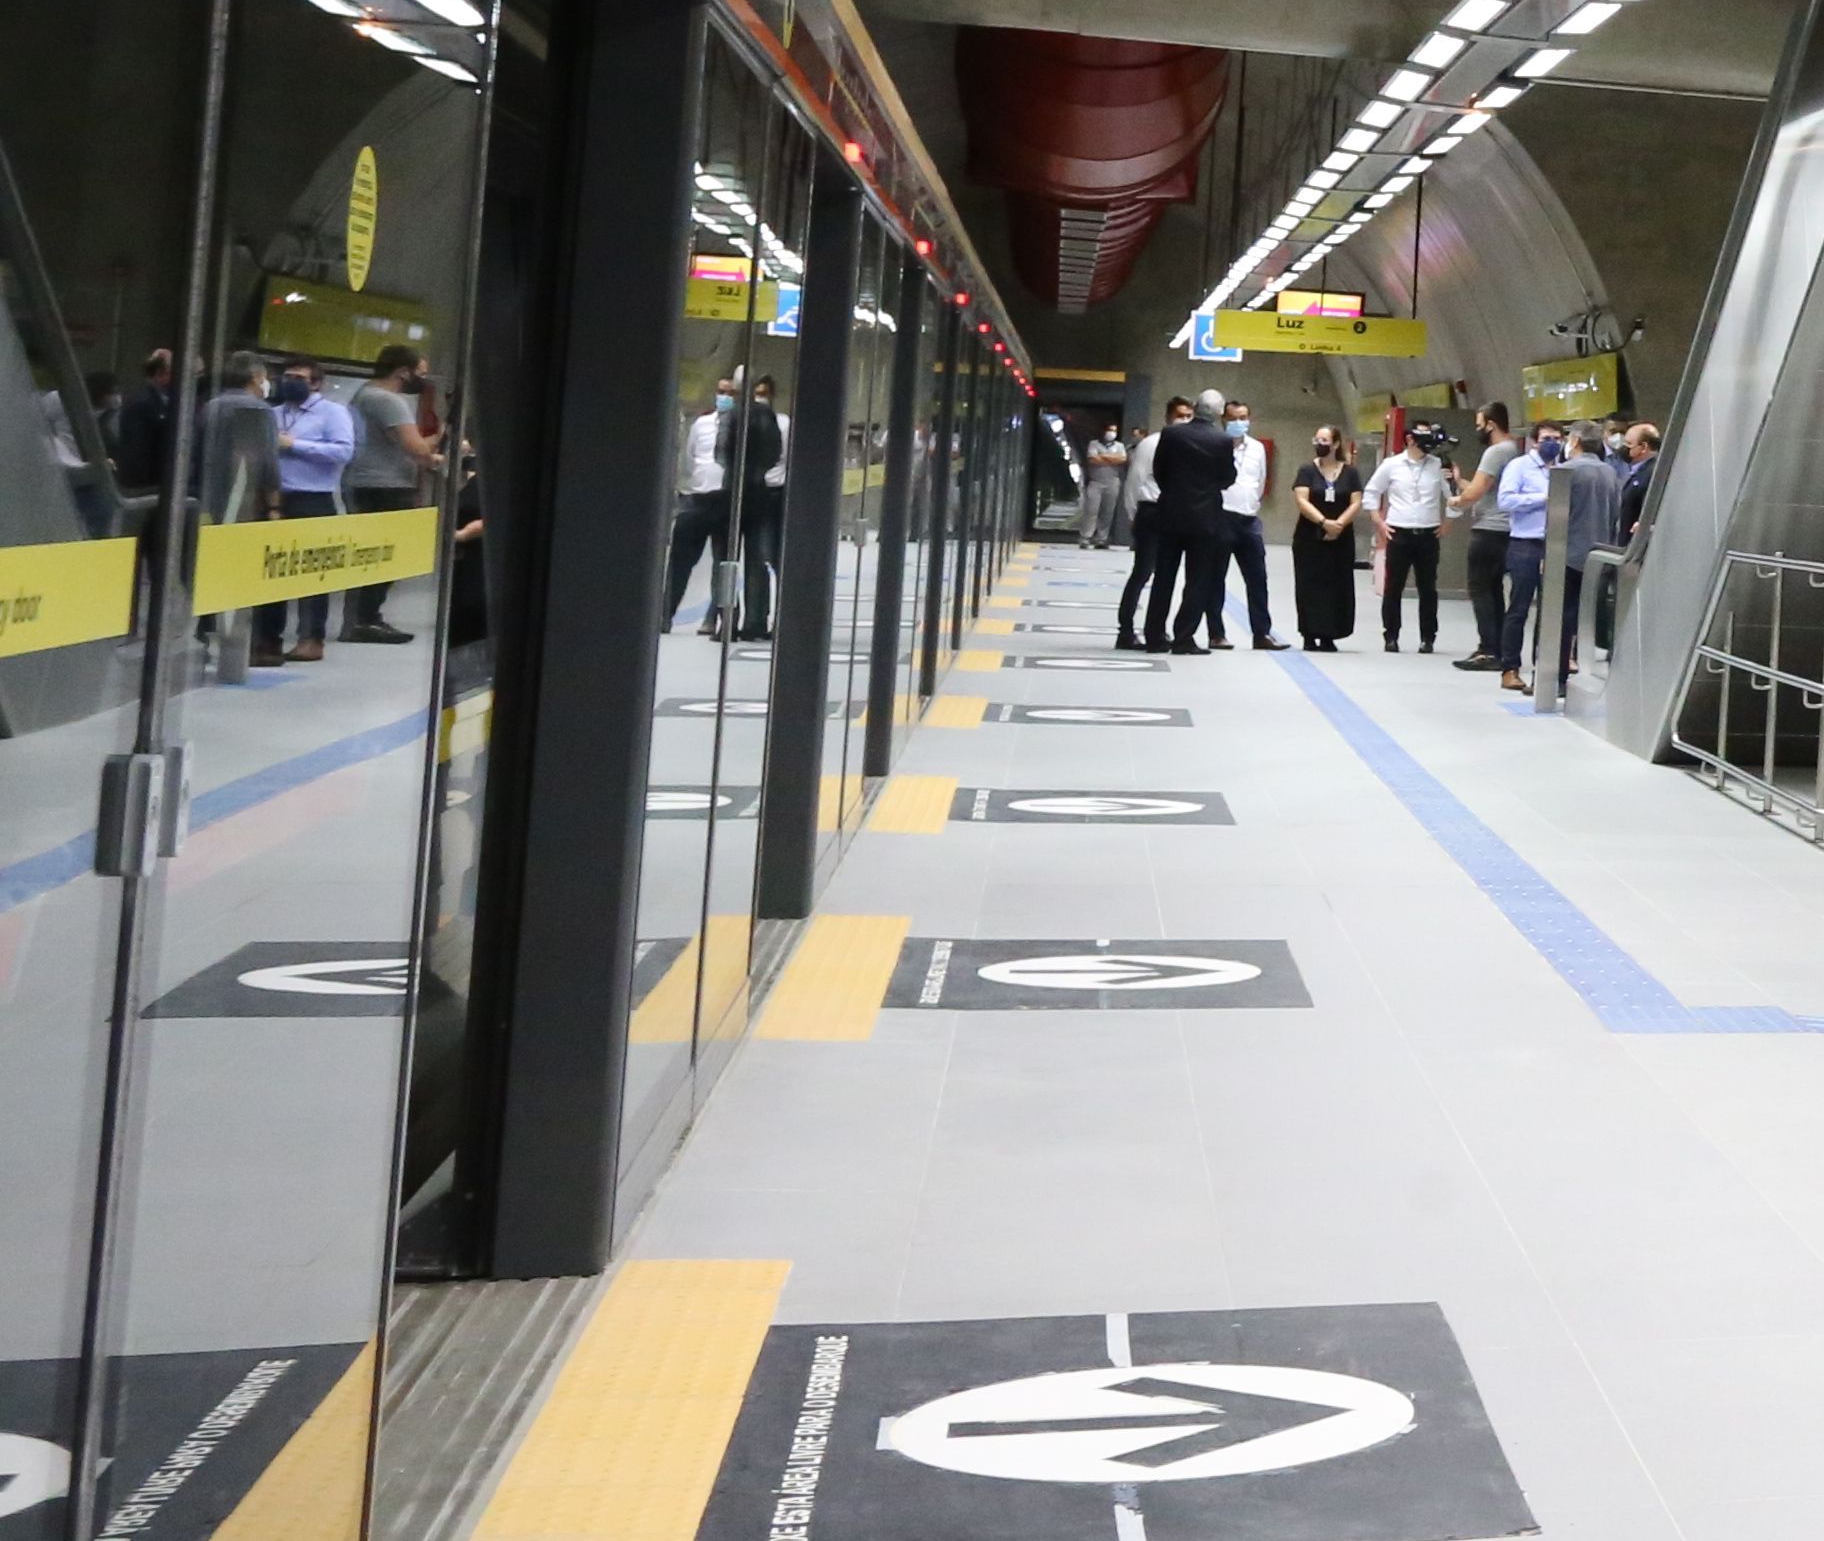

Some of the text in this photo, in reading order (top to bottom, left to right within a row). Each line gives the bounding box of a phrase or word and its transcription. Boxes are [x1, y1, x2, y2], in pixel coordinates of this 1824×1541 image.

[1277, 316, 1304, 329] Luz
[804, 1335, 848, 1398] DESEMBARQUE
[802, 1399, 836, 1408] O
[794, 1408, 834, 1435] PARA
[786, 1435, 828, 1465] LIVRE
[771, 1495, 815, 1524] ESTA
